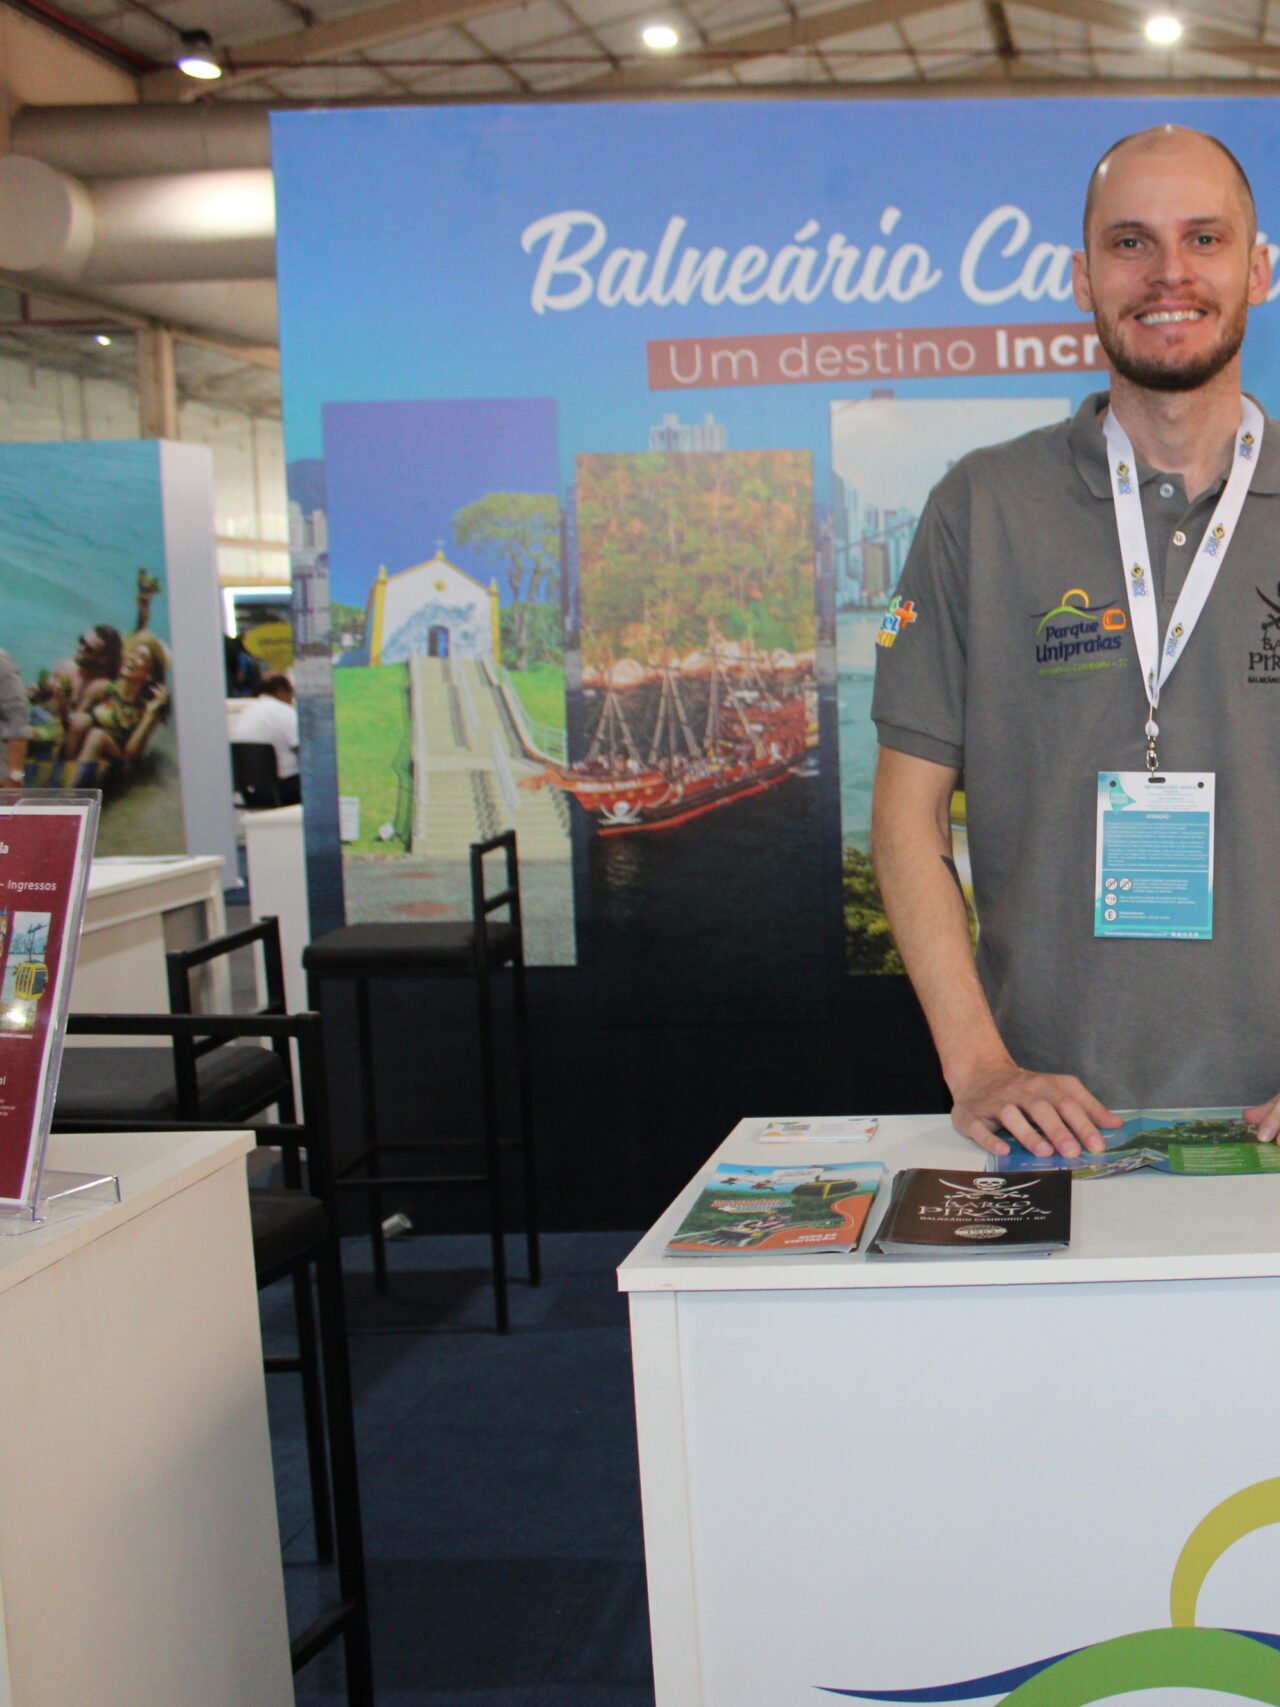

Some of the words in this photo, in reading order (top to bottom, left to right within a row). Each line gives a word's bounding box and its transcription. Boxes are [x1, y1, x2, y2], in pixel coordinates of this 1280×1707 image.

[520, 206, 942, 315] Balneário
[669, 343, 758, 384] Um
[779, 332, 976, 377] destino
[996, 329, 1101, 369] Incr
[1046, 622, 1098, 642] Parque
[1036, 635, 1122, 663] Unipraias
[7, 880, 57, 892] Ingressos
[919, 1206, 1052, 1217] PIRATA
[944, 1200, 1031, 1208] BARCO
